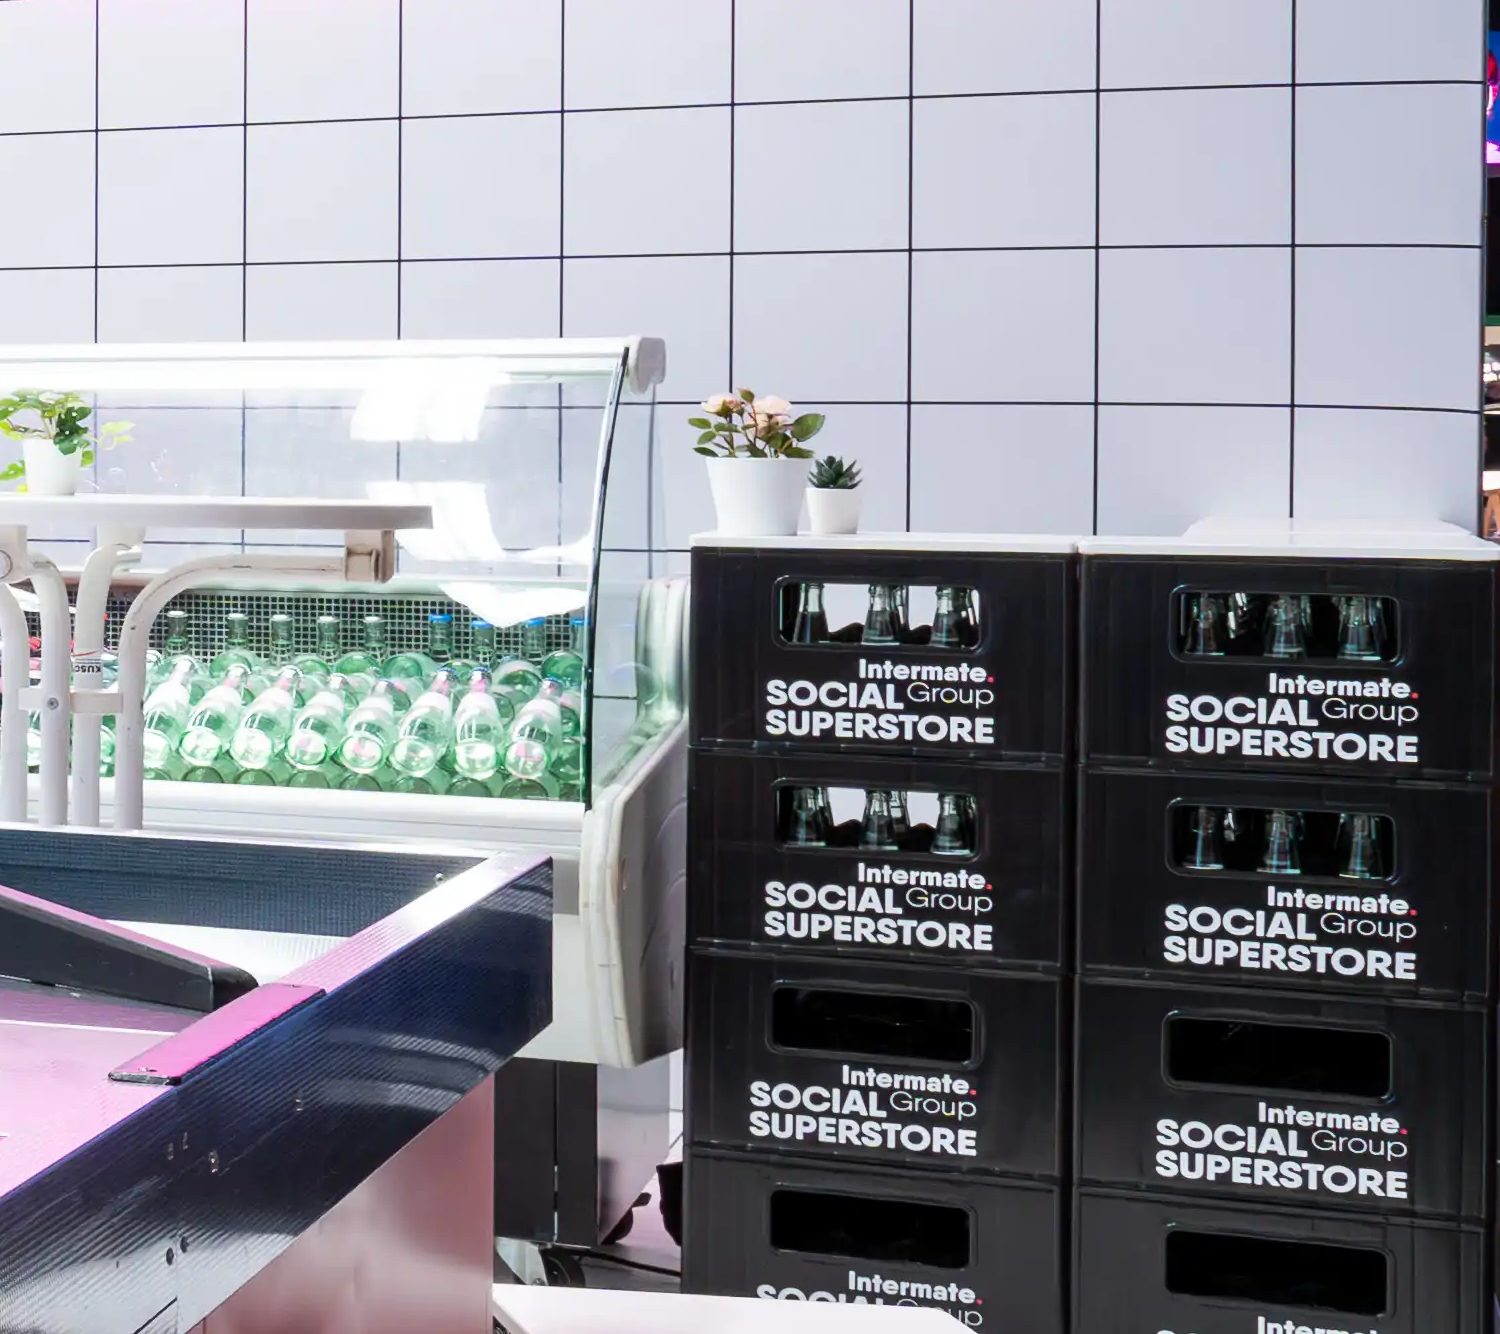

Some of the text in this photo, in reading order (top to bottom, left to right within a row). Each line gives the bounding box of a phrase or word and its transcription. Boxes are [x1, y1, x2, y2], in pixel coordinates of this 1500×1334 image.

[859, 659, 995, 683] Intermate.
[1269, 673, 1418, 701] Intermate.
[766, 681, 995, 710] SOCIAL Group
[1166, 694, 1419, 726] SOCIAL Group
[766, 710, 995, 744] SUPERSTORE
[1165, 726, 1418, 763] SUPERSTORE
[858, 864, 992, 890] Intermate.
[765, 883, 993, 915] SOCIAL Group
[1267, 887, 1416, 916] Intermate.
[764, 912, 993, 951] SUPERSTORE
[1165, 904, 1417, 943] SOCIAL Group
[1163, 936, 1416, 979] SUPERSTORE
[842, 1065, 977, 1097] Intermate.
[750, 1082, 977, 1121] SOCIAL Group
[1259, 1102, 1408, 1135] Intermate.
[748, 1111, 977, 1156] SUPERSTORE
[1156, 1119, 1408, 1161] SOCIAL Group
[1155, 1151, 1408, 1199] SUPERSTORE
[848, 1270, 983, 1305] Intermate.
